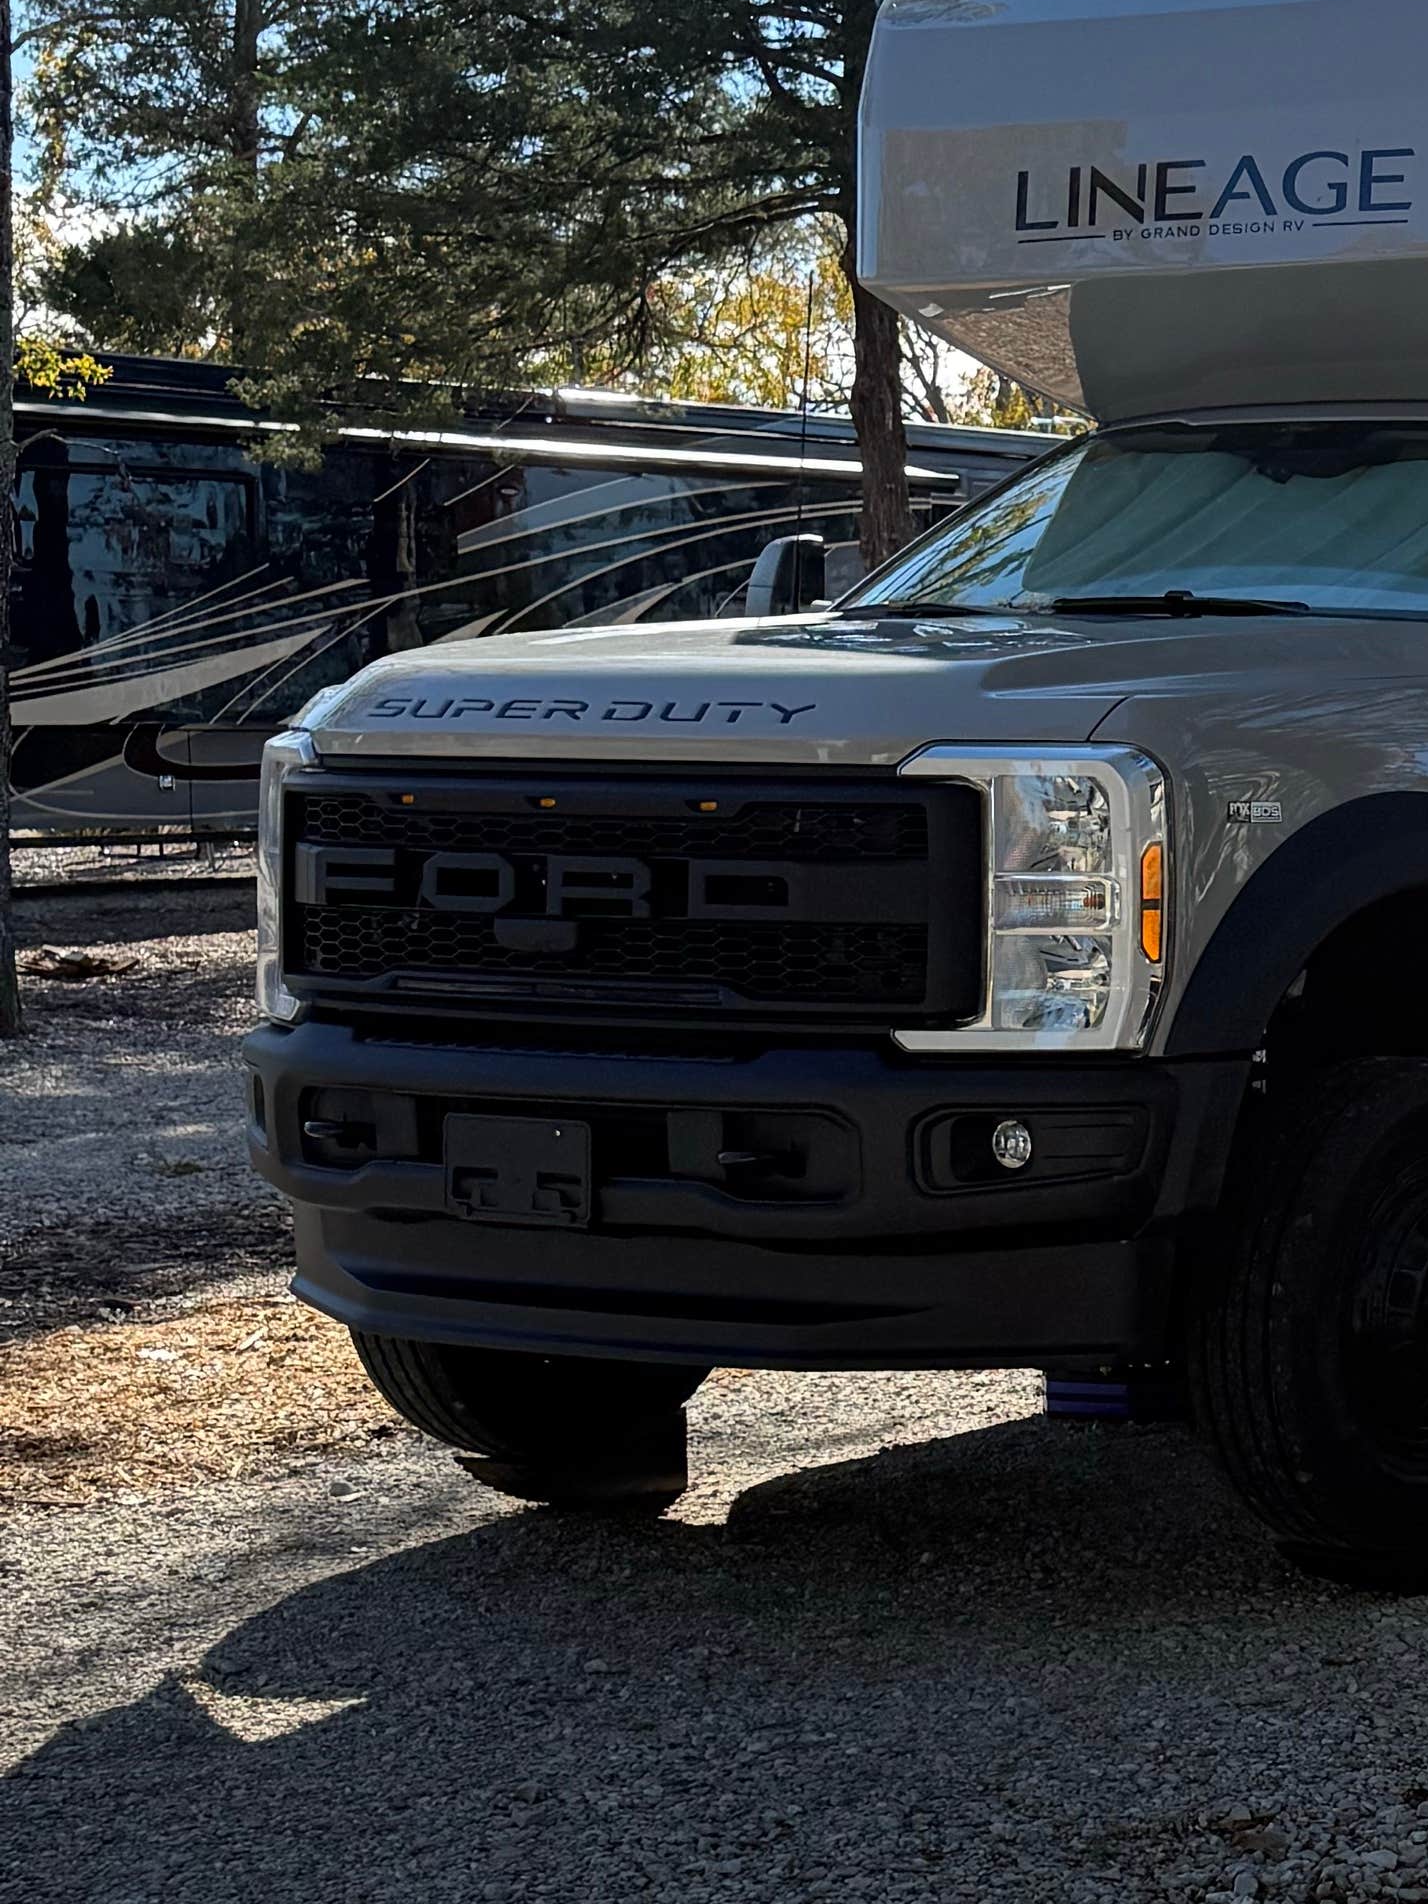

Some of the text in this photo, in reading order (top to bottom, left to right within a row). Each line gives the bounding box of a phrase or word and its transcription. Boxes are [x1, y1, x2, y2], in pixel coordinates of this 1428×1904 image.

[1015, 148, 1415, 231] LINEAGE
[1112, 219, 1304, 241] BY GRAND DESIGN RV
[367, 698, 816, 724] SUPER DUTY
[296, 841, 802, 920] FORD
